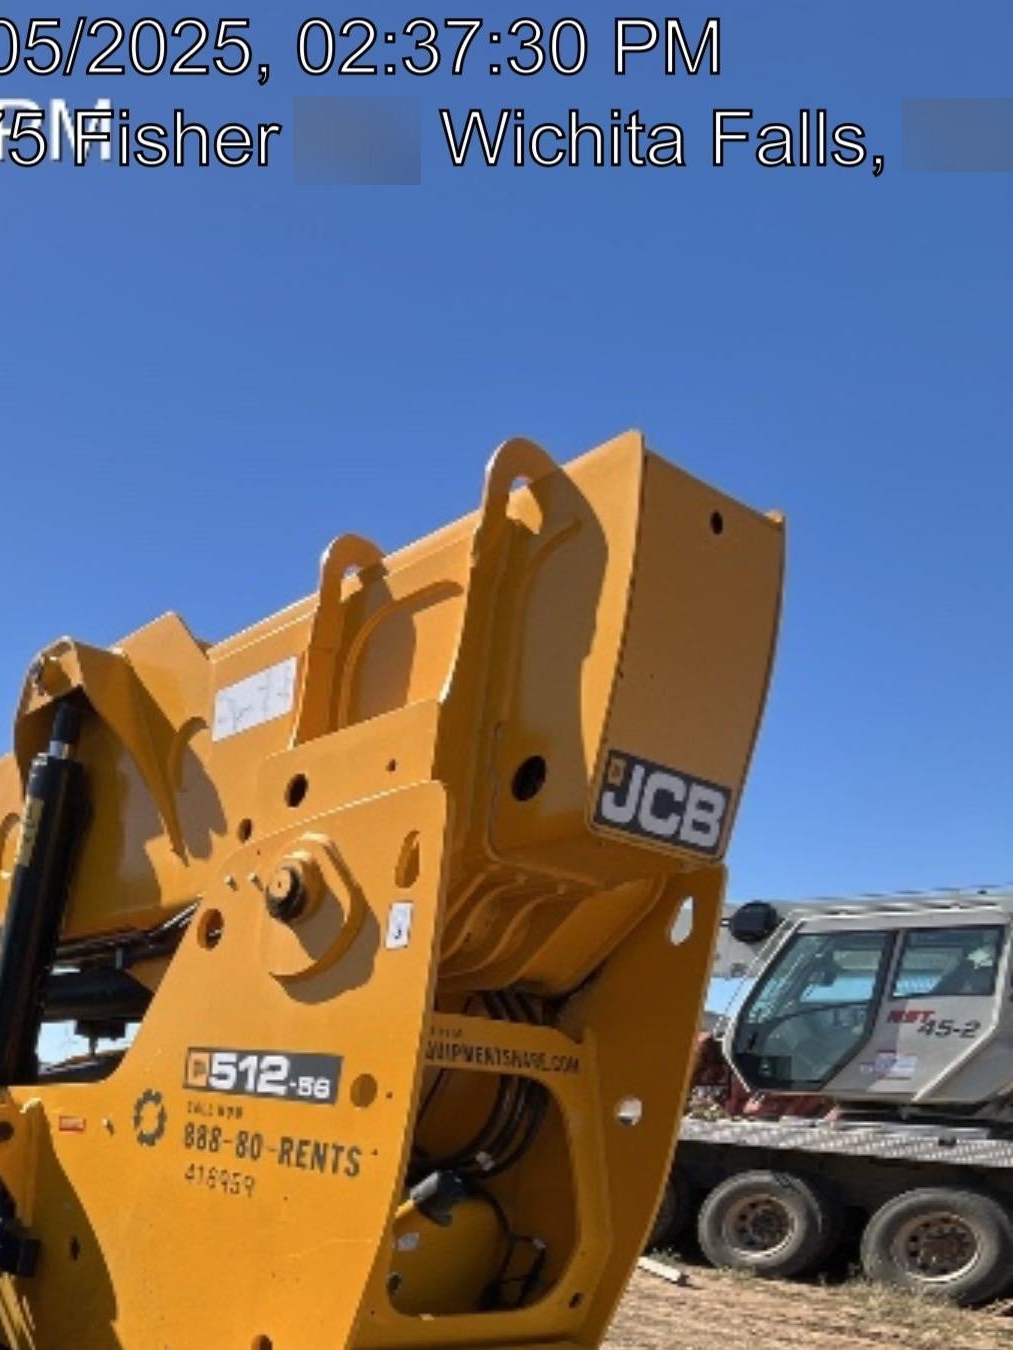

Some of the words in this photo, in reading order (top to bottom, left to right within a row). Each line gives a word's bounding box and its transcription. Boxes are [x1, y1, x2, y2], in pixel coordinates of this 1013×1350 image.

[601, 764, 726, 847] JCB
[917, 1020, 980, 1038] 45-2
[184, 1121, 363, 1178] 888-80-RENTS
